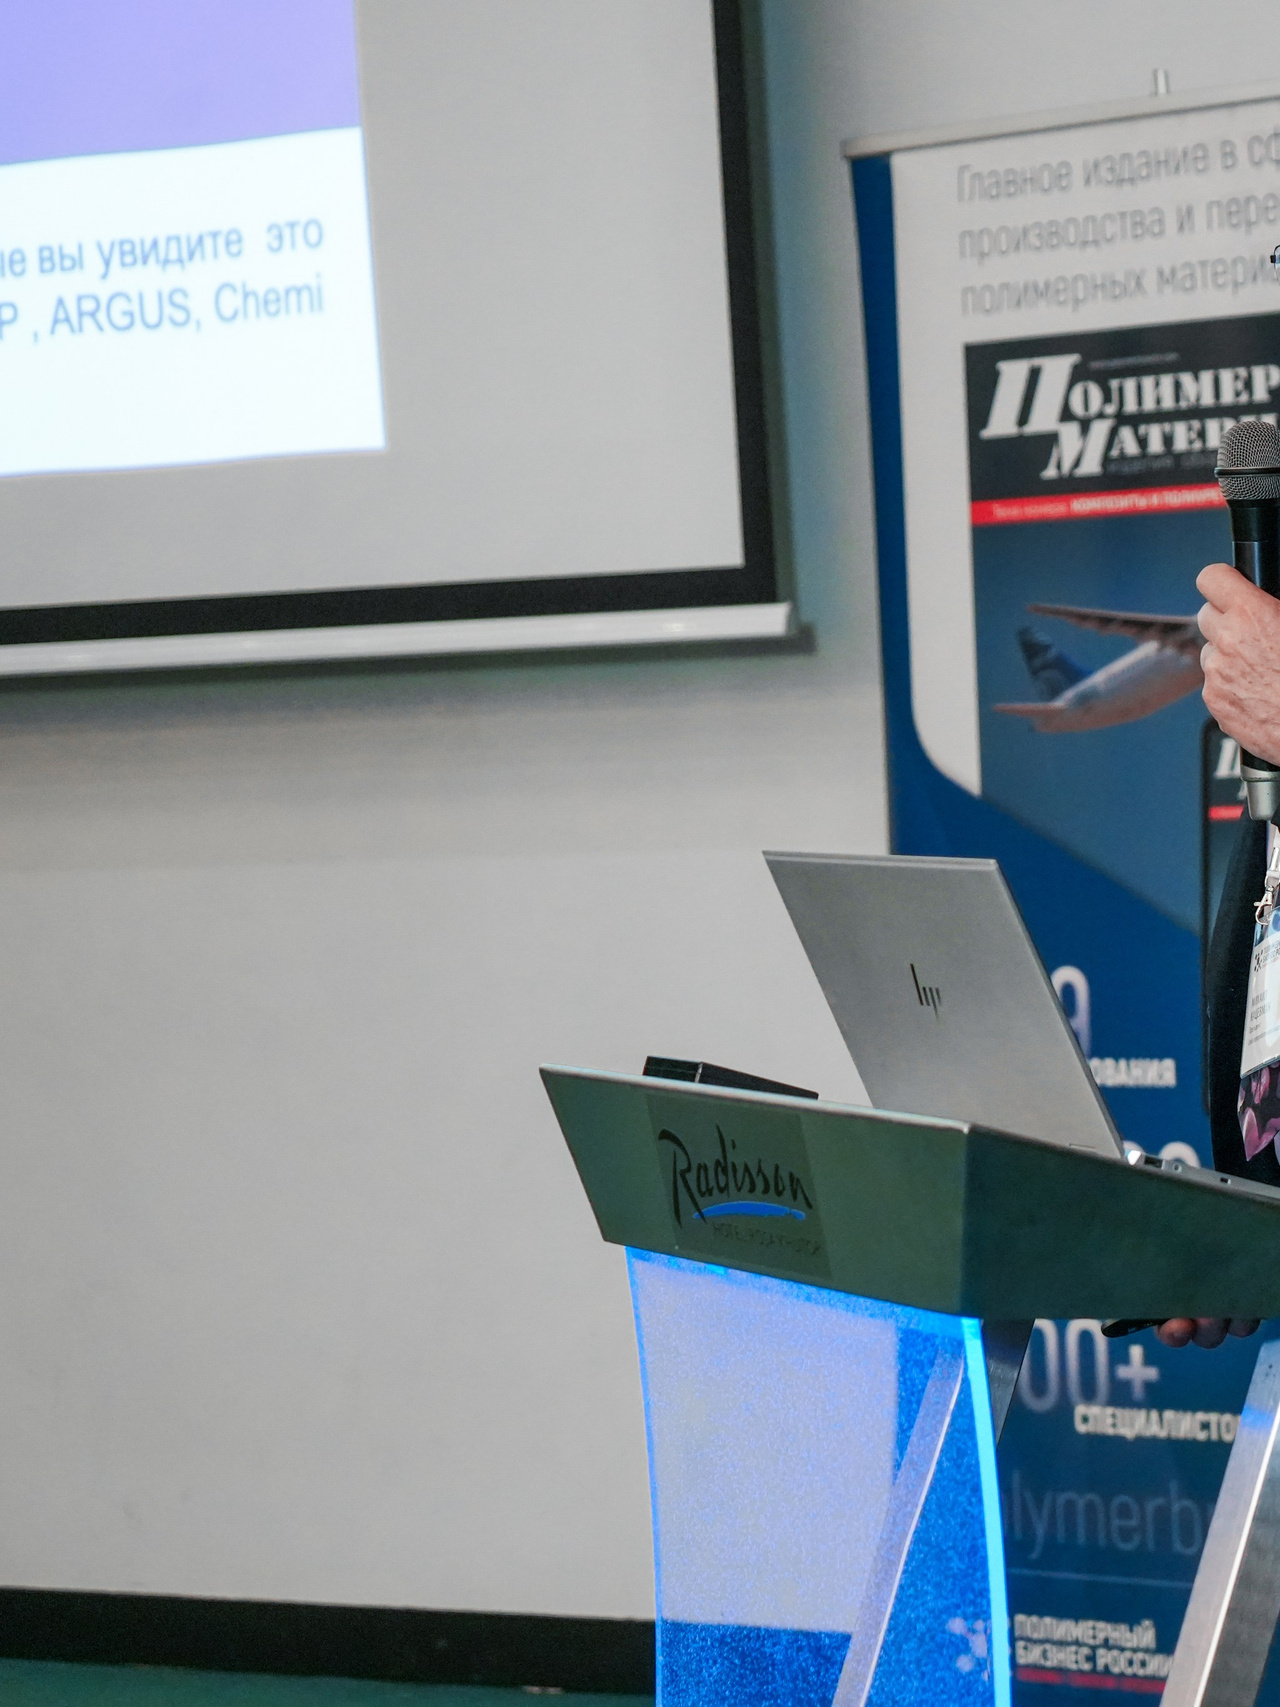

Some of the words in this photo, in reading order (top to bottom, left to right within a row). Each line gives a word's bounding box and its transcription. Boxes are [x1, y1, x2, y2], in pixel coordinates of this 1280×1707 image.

[957, 158, 1073, 203] Главное
[1082, 140, 1209, 188] издание
[1222, 138, 1237, 171] в
[38, 242, 84, 275] вы
[97, 226, 243, 281] увидите
[265, 217, 324, 252] это
[958, 204, 1166, 266] производства
[1174, 203, 1196, 234] и
[49, 287, 202, 336] ARGUS,
[213, 271, 325, 323] Chemi
[961, 264, 1147, 316] полимерных
[1088, 1056, 1177, 1088] ОВАНИЯ
[657, 1122, 814, 1230] Radisson
[1074, 1403, 1241, 1444] СПЕЦИАЛИСТО
[1014, 1612, 1157, 1649] ПОЛИМЕРНЫЙ
[1015, 1639, 1094, 1672] БИЗНЕС
